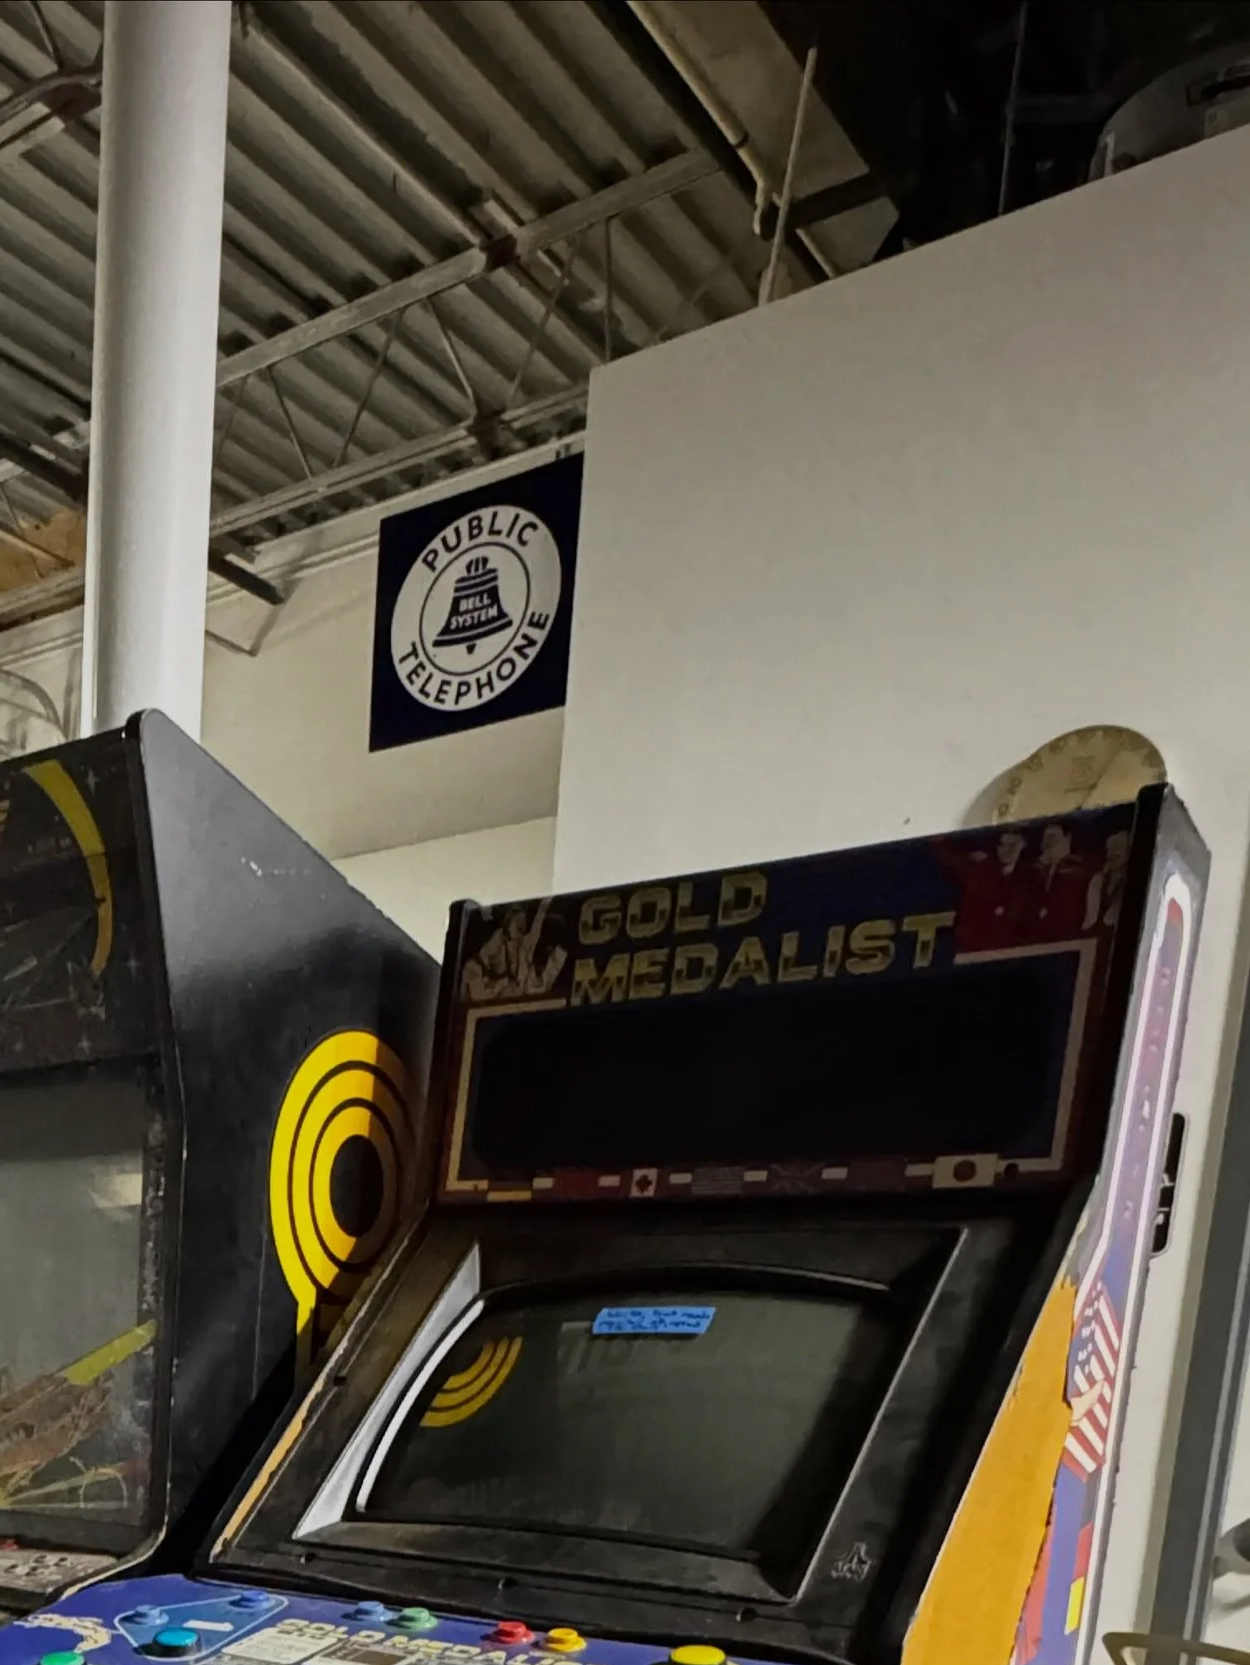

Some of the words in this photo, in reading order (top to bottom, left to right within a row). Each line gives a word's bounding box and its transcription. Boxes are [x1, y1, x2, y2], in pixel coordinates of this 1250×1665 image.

[421, 510, 539, 573] PUBLIC
[449, 606, 498, 631] SYSTEM
[459, 592, 492, 613] BELL
[398, 610, 550, 706] TELEPHONE
[577, 870, 769, 946] GOLD
[568, 910, 957, 1005] MEDALIST
